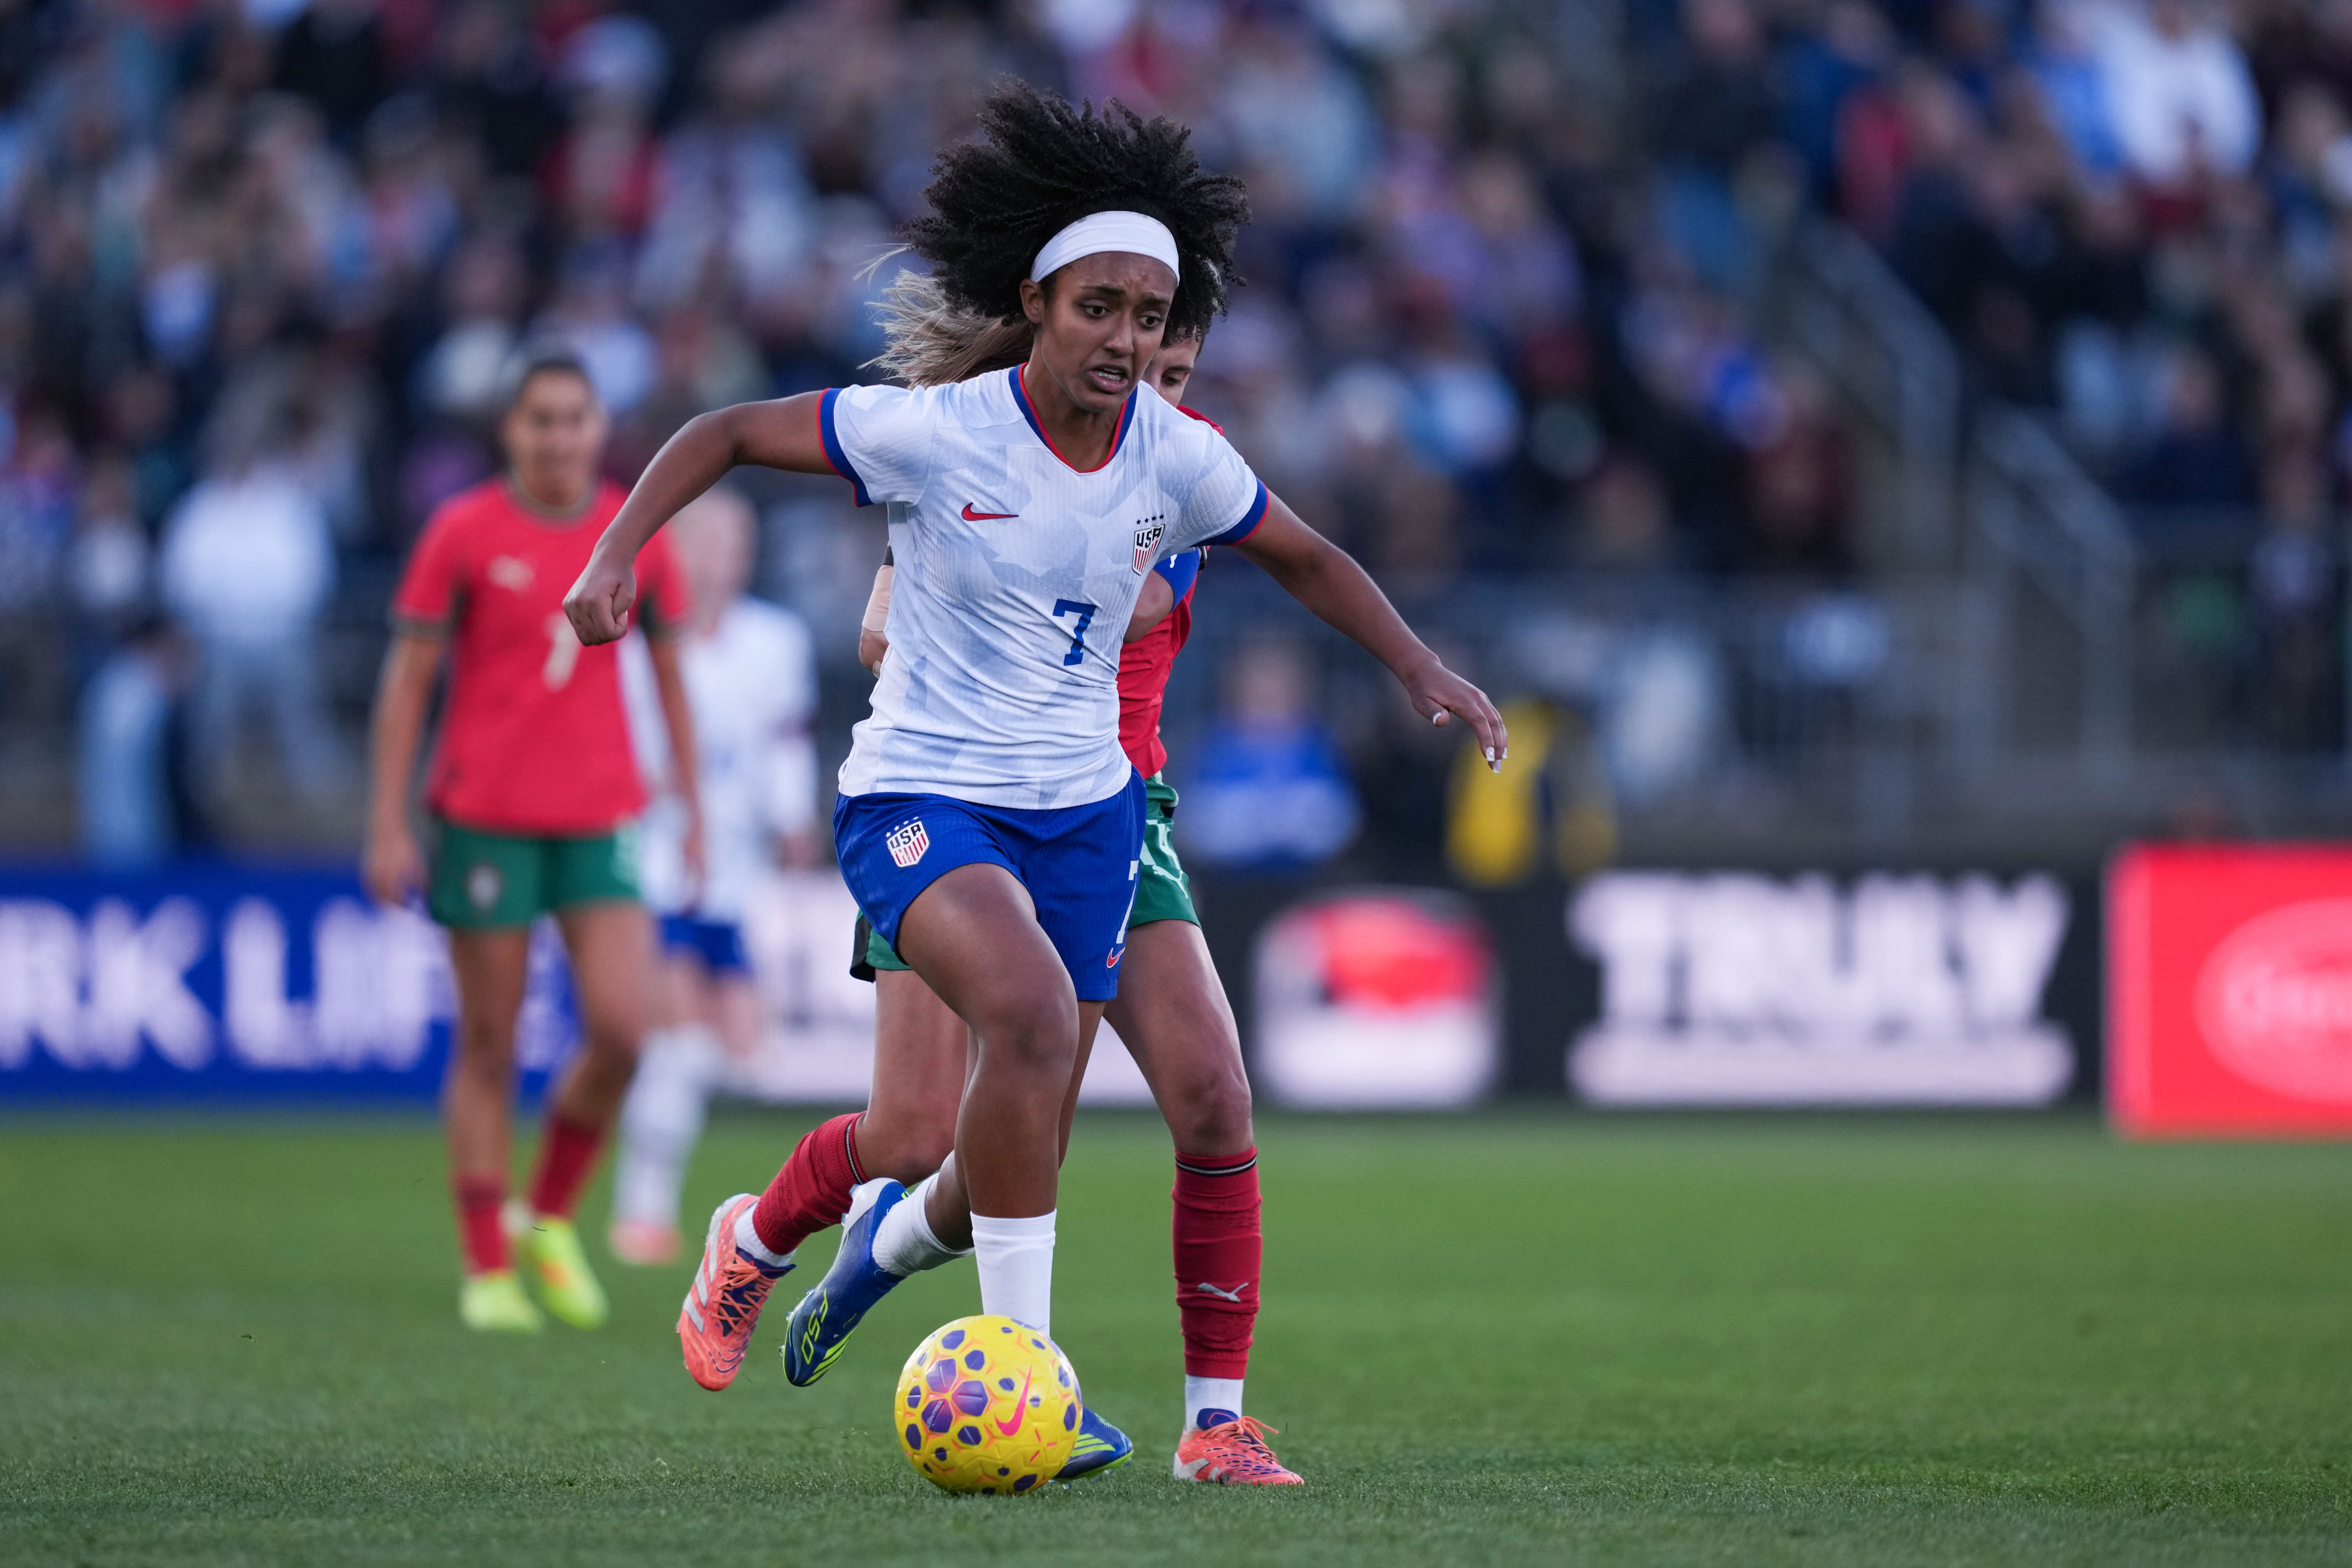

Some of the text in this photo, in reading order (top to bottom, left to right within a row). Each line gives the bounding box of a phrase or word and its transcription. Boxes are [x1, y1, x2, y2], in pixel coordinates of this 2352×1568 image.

[1136, 527, 1161, 549] USA
[1052, 598, 1097, 666] 7
[890, 824, 922, 849] USA
